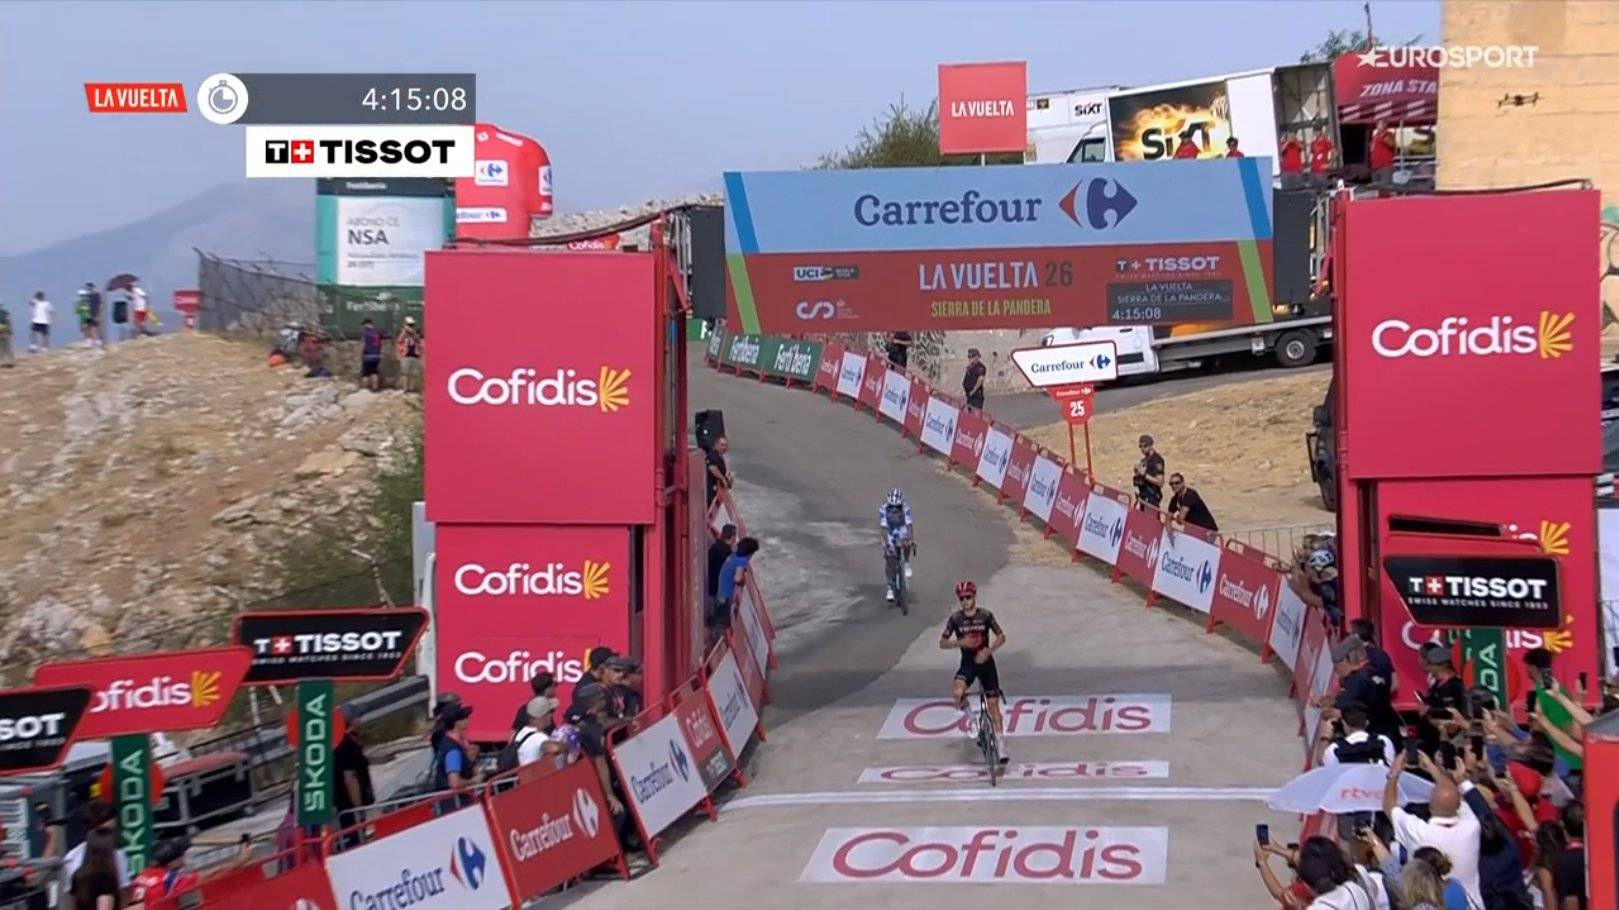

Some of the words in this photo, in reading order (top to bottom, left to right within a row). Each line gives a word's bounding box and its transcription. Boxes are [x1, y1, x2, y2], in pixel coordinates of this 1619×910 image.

[1361, 79, 1403, 97] ZONA
[951, 101, 967, 117] LA
[968, 100, 1015, 117] VUELTA
[854, 191, 1042, 228] Carrefour
[348, 229, 389, 245] NSA
[796, 269, 819, 279] UCI
[919, 264, 947, 290] LA
[951, 261, 1039, 289] VUELTA
[1045, 261, 1073, 287] 26
[1145, 256, 1219, 271] TISSOT
[1160, 282, 1193, 291] VUELTA
[931, 301, 969, 317] SIERRA
[971, 300, 984, 316] DE
[987, 300, 1000, 316] LA
[1003, 299, 1051, 315] PANDERA
[1112, 307, 1162, 320] 4:15:08
[1372, 315, 1538, 358] Cofidis
[1031, 360, 1085, 373] Carrefour
[447, 367, 599, 406] Cofidis
[1070, 401, 1085, 417] 25
[1161, 550, 1195, 583] Carrefour
[454, 562, 582, 596] Cofidis
[1219, 572, 1254, 606] Carrefour
[1445, 577, 1547, 599] TISSOT
[1408, 597, 1438, 606] SWISS
[1442, 598, 1487, 607] WATCHES
[1490, 600, 1520, 609] SINCE
[294, 630, 402, 654] TISSOT
[454, 650, 582, 684] Cofidis
[903, 697, 1152, 735] Cfidis
[630, 761, 674, 804] Carrefour
[509, 811, 573, 861] Carrefour
[833, 829, 1142, 881] Cofidis
